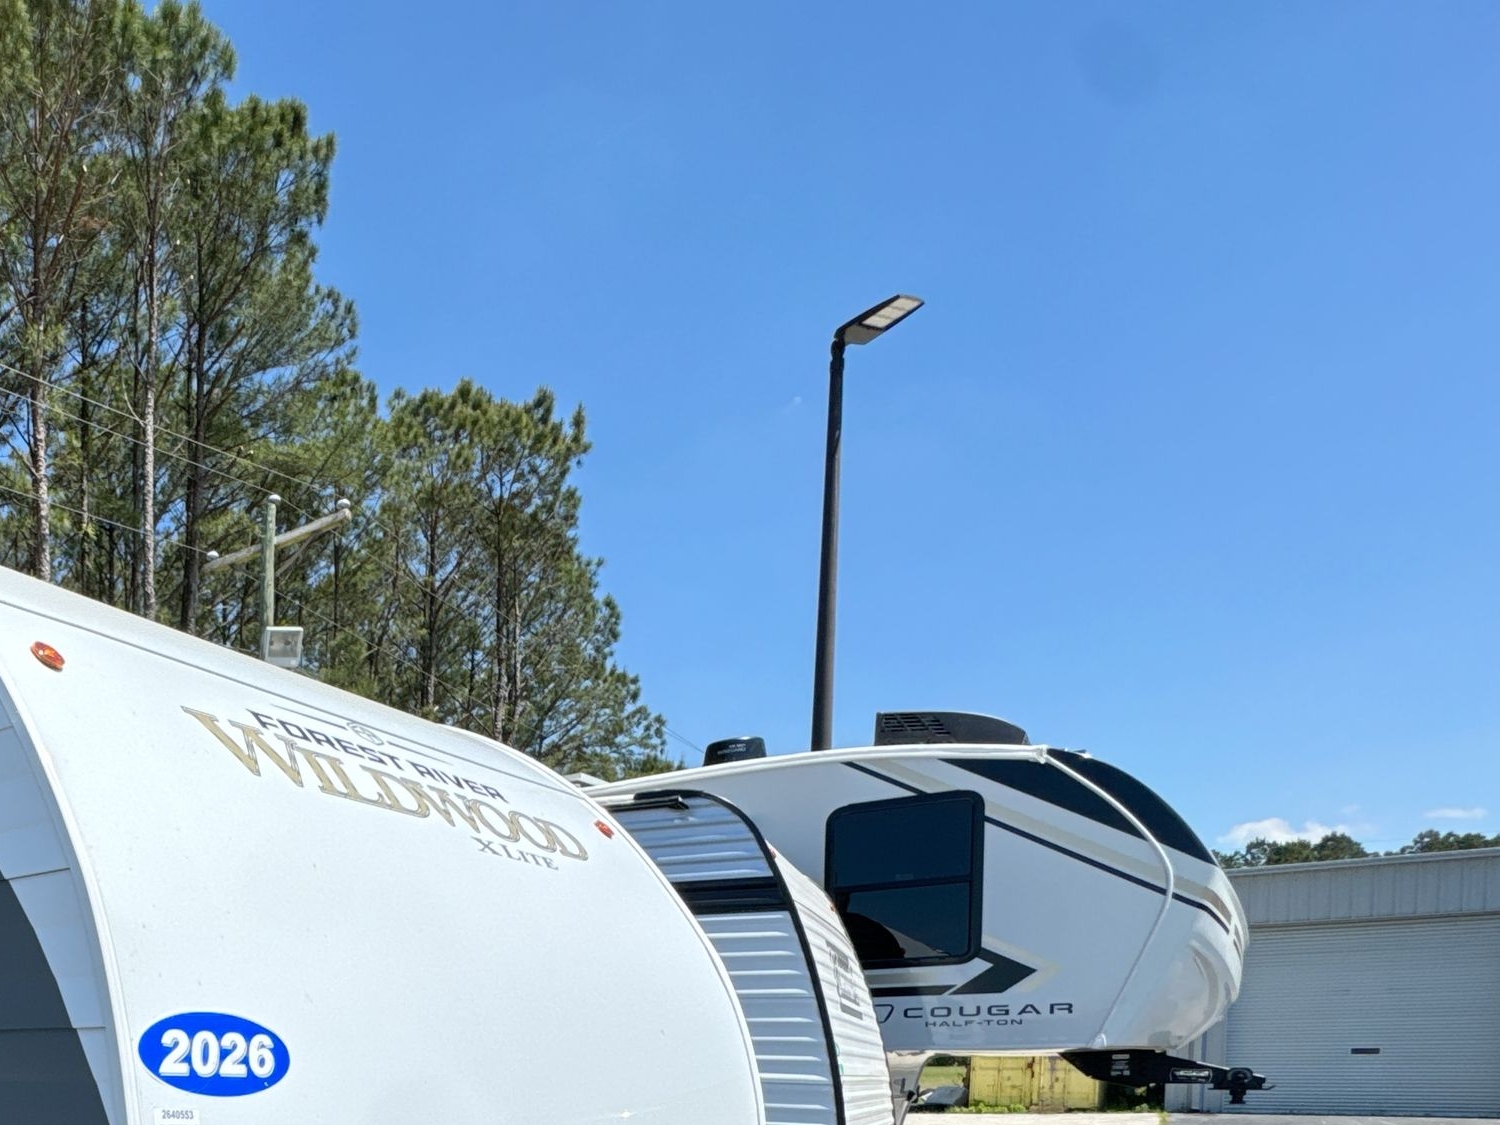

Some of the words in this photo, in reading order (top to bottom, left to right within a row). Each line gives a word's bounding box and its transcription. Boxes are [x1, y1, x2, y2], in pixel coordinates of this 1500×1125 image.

[246, 708, 403, 770] FOREST
[407, 761, 508, 802] RIVER
[180, 705, 589, 861] WILDWOOD
[903, 1003, 1074, 1018] COUGAR
[925, 1019, 1023, 1028] HALF-TON
[159, 1029, 275, 1078] 2026
